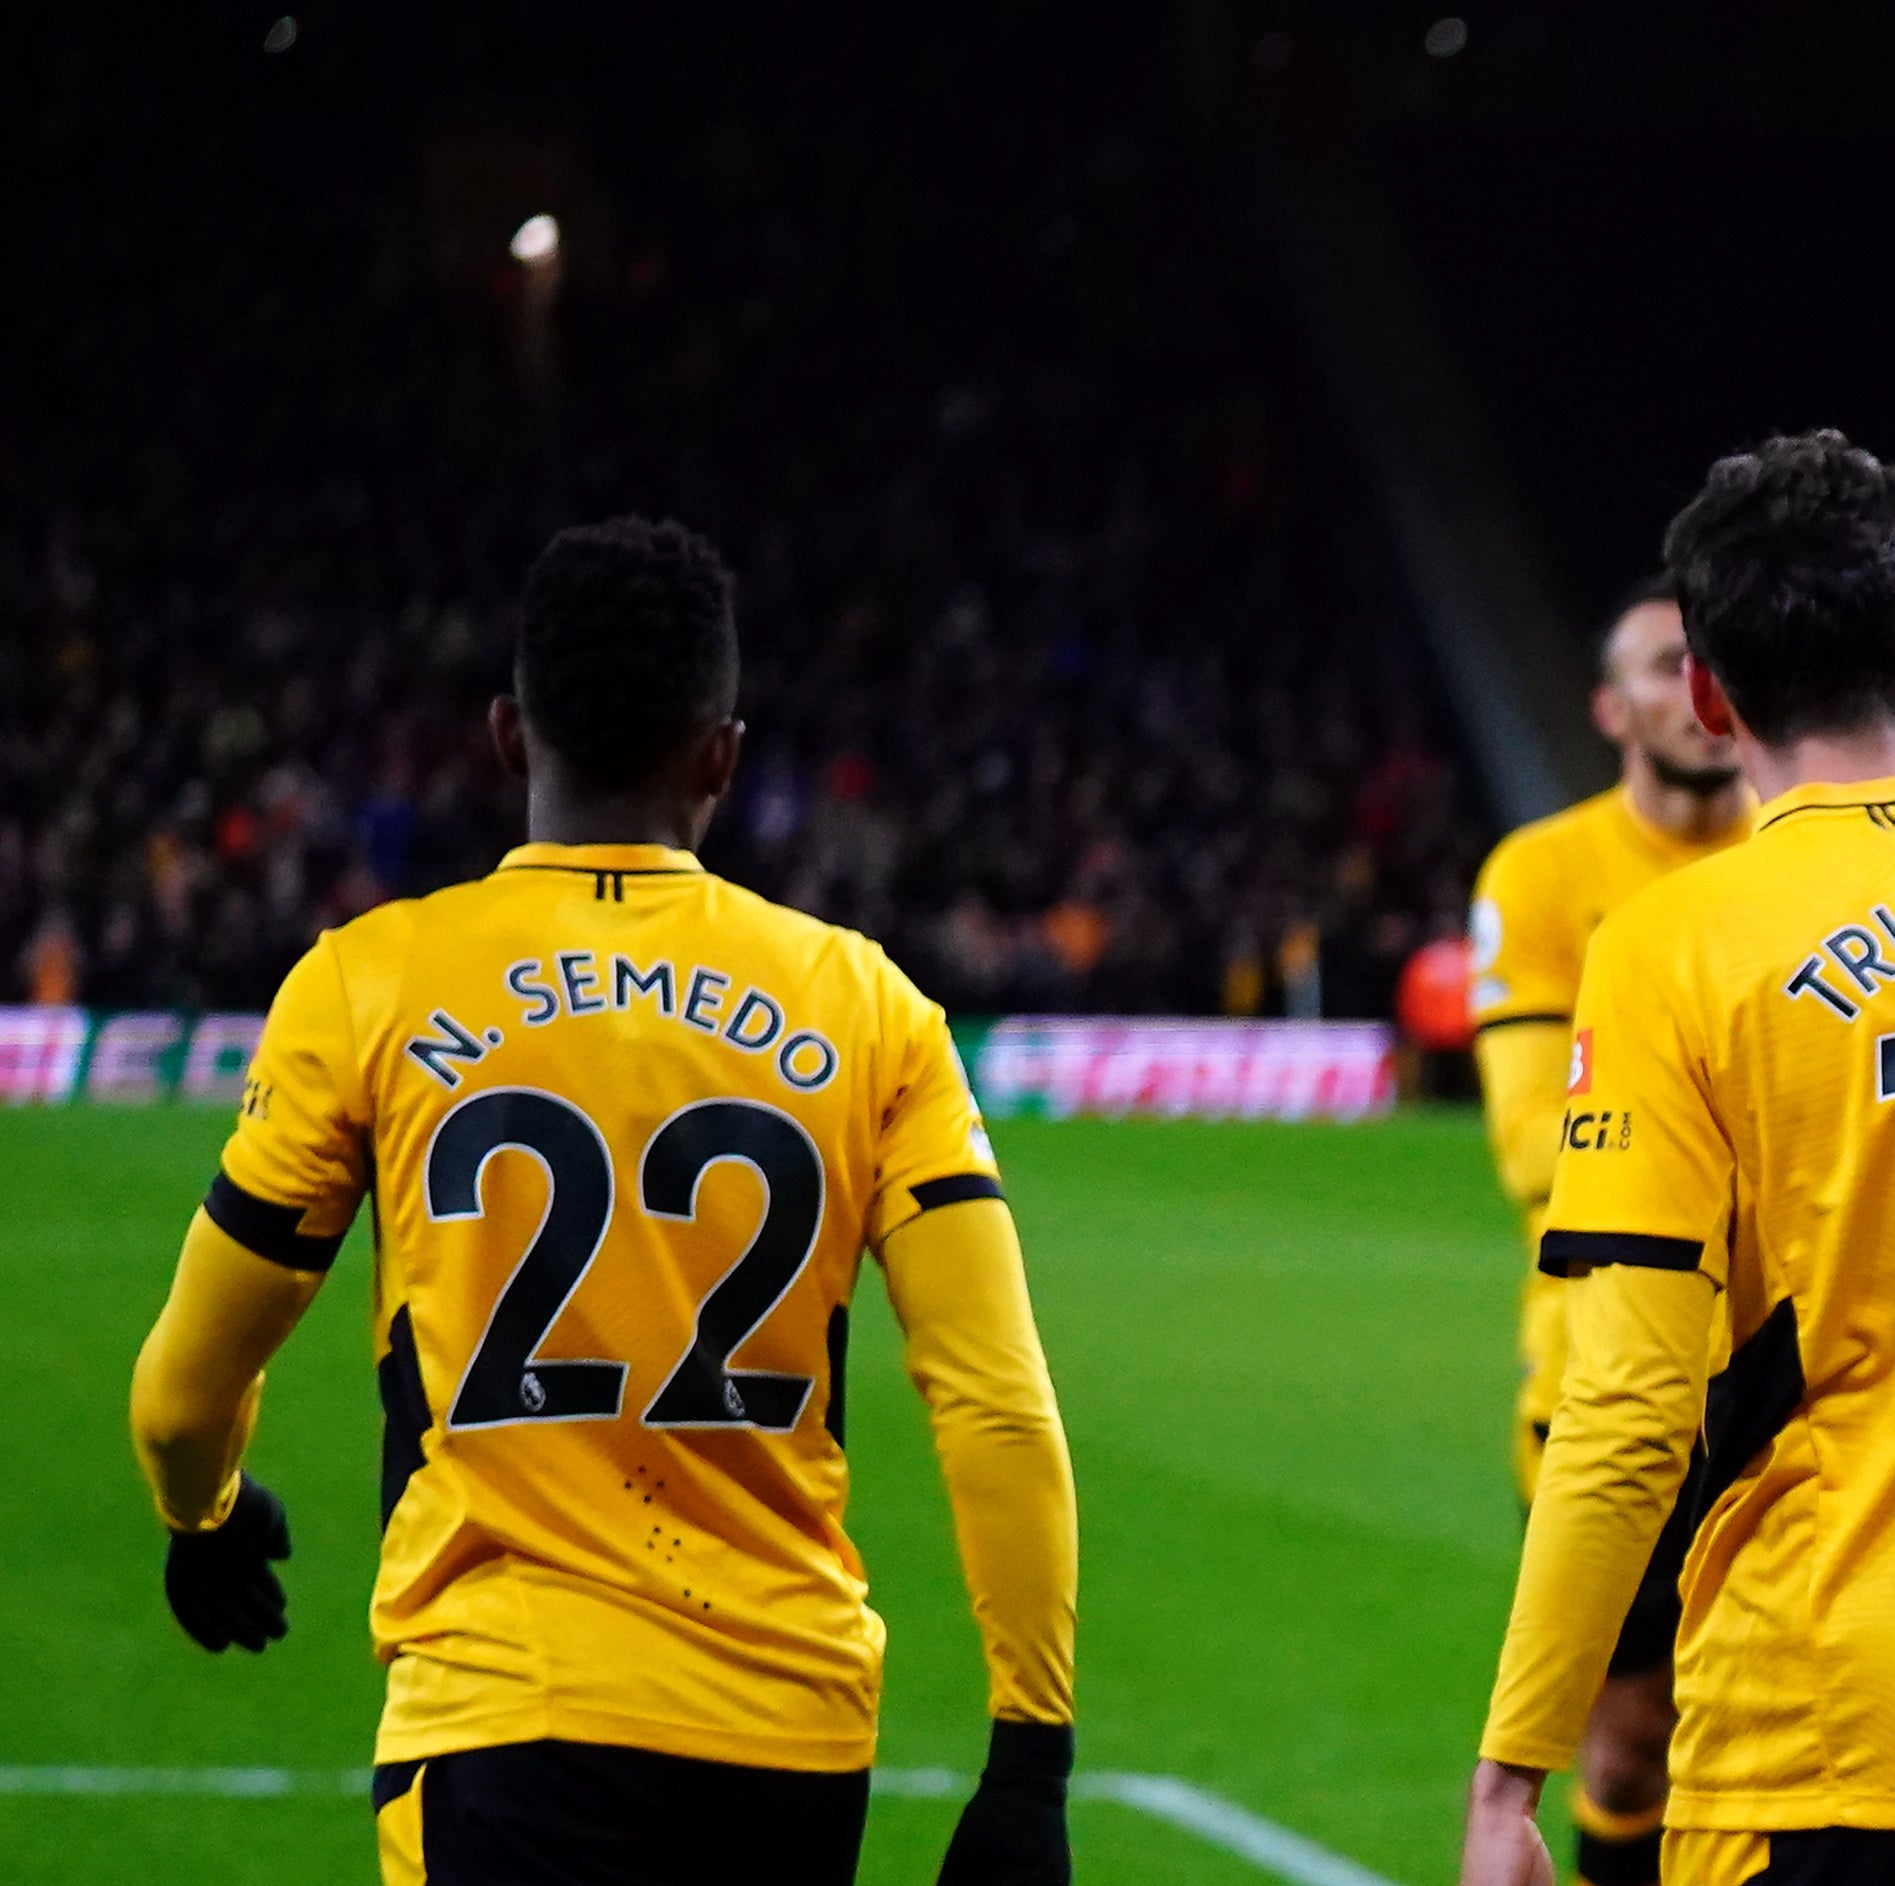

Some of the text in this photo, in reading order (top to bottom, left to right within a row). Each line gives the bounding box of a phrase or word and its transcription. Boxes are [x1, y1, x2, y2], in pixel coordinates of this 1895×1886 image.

[405, 951, 840, 1095] N. SEMEDO
[424, 1085, 826, 1434] 22
